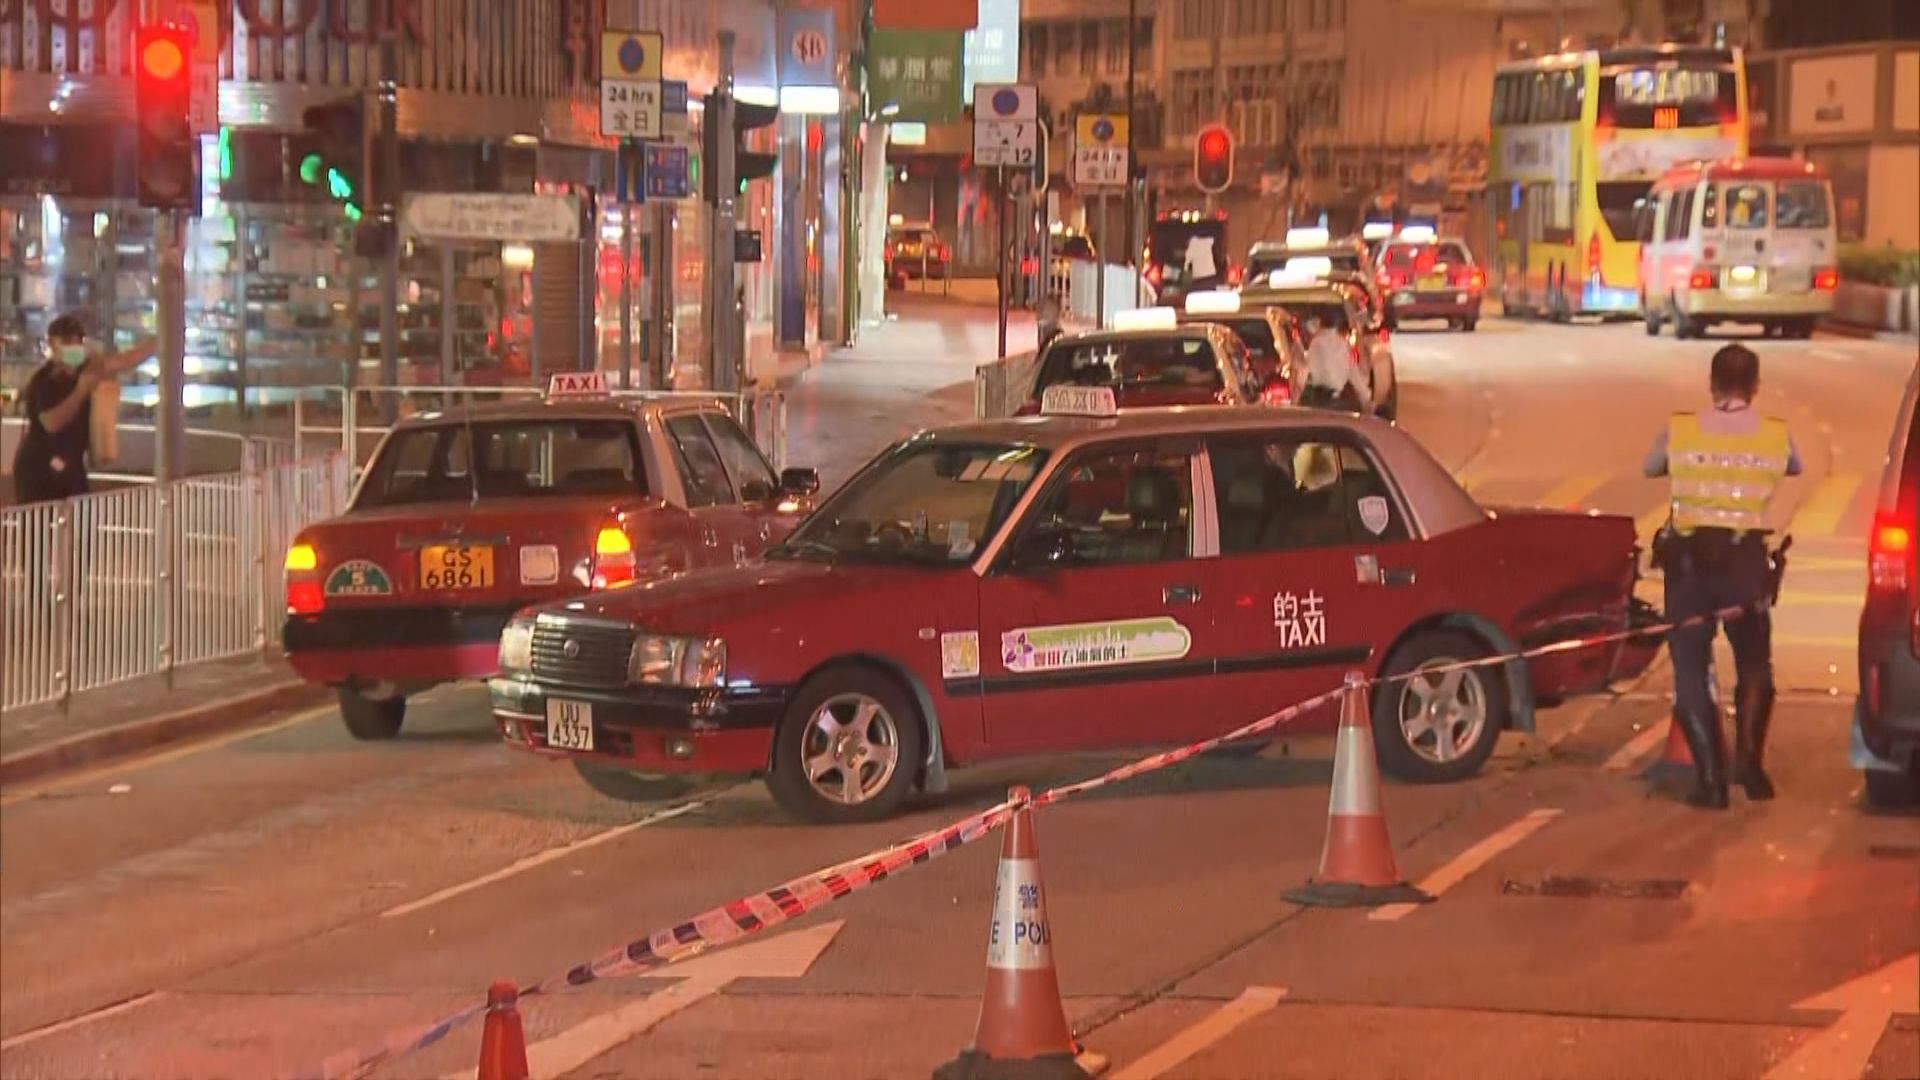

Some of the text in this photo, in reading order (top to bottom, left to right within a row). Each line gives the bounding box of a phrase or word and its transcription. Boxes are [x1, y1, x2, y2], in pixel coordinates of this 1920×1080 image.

[608, 86, 654, 105] 24 hrs
[613, 110, 649, 131] 全日
[1015, 122, 1024, 139] 7
[1015, 148, 1032, 163] 12
[555, 374, 598, 391] TAXI
[1048, 388, 1098, 410] TAXI
[442, 547, 472, 568] GS
[426, 566, 485, 588] 6861
[1273, 588, 1324, 619] 的士
[1274, 614, 1326, 648] TAXI
[559, 702, 580, 724] UU
[552, 722, 590, 749] 4337
